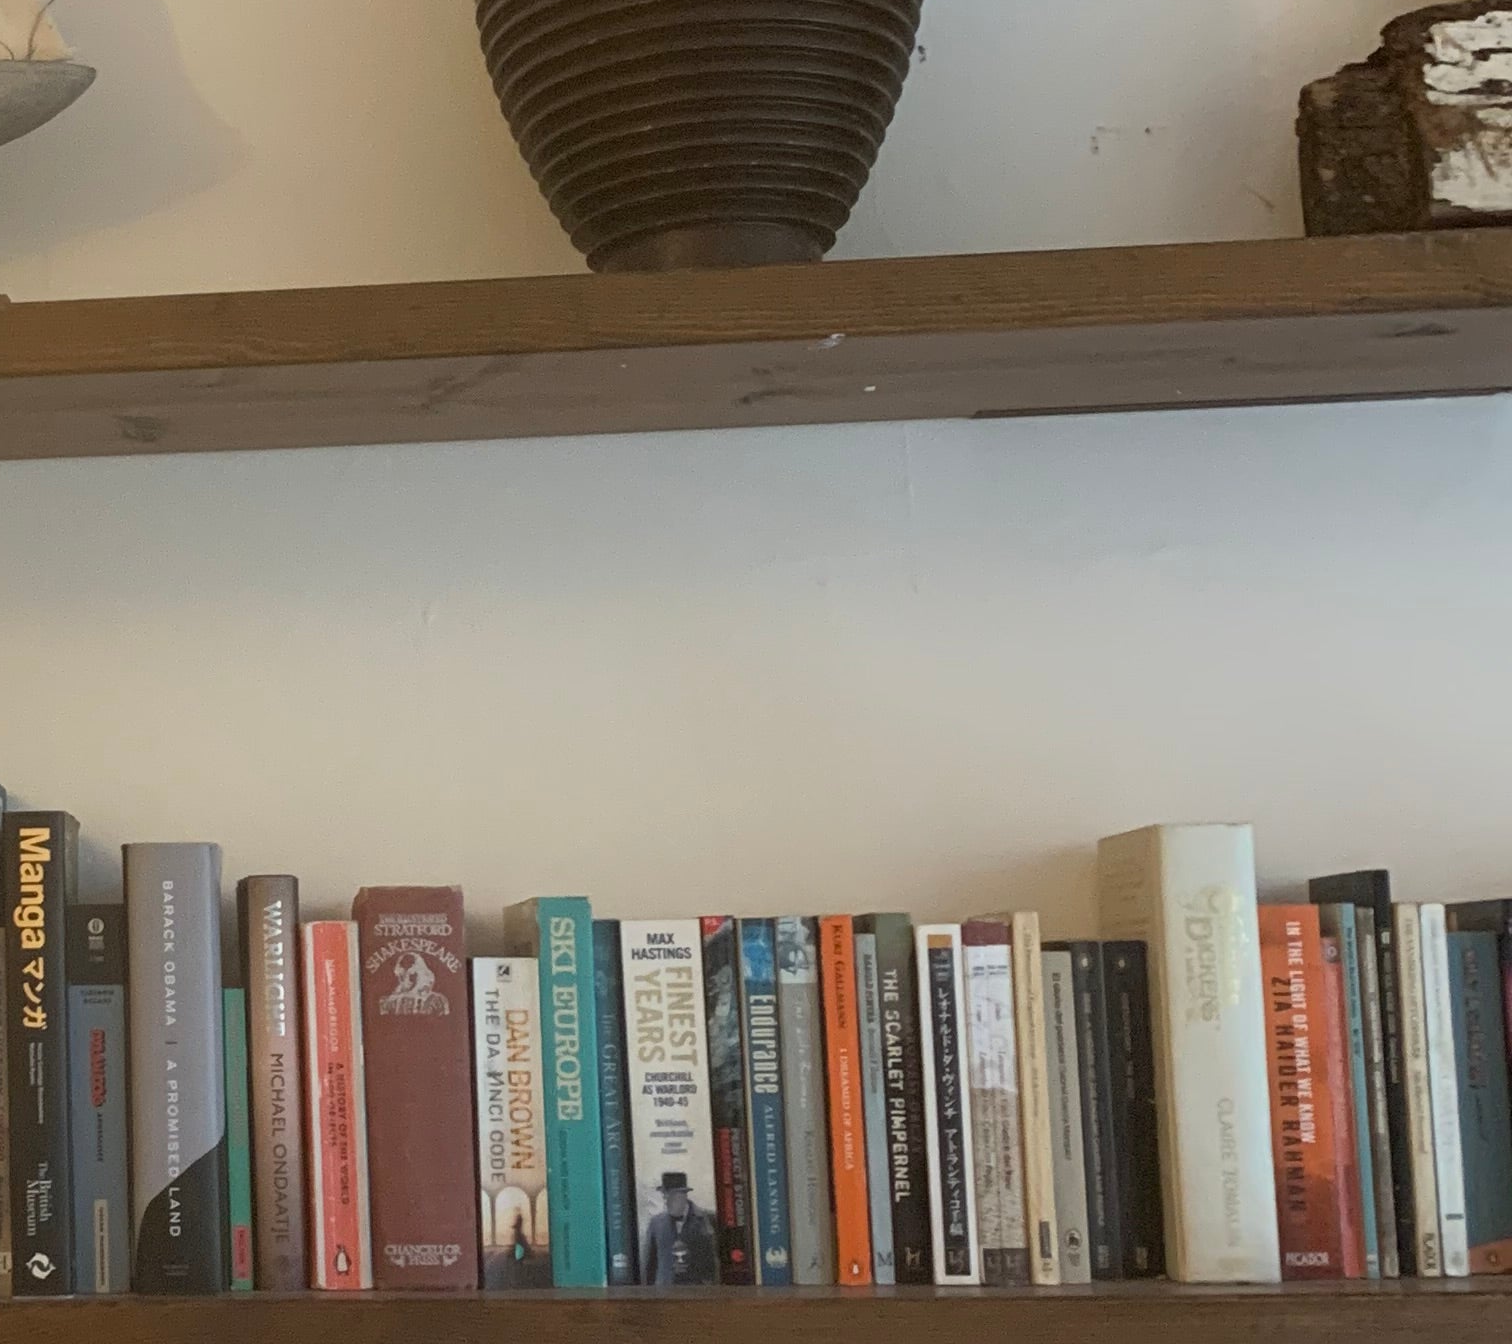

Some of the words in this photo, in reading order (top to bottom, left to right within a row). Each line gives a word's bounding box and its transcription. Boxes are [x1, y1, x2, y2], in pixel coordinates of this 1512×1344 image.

[12, 827, 51, 950] Manga
[161, 880, 176, 953] BARACK
[374, 924, 453, 937] STRATFORD
[646, 932, 675, 946] MAX
[1285, 920, 1301, 936] IN
[261, 899, 287, 1037] WARLIGHT
[365, 937, 462, 974] SHAKESPEARE
[550, 915, 577, 976] SKI
[631, 946, 692, 961] HASTINGS
[1287, 941, 1304, 965] THE
[21, 958, 48, 1031] マンガ
[163, 961, 178, 1027] OBAMA
[484, 989, 501, 1025] THE
[833, 960, 848, 1029] GALLMANN
[882, 969, 900, 1002] THE
[1271, 976, 1291, 1012] ZIA
[1289, 969, 1307, 1009] LIGHT
[504, 1009, 533, 1063] DAN
[633, 969, 665, 1064] YEARS
[665, 966, 698, 1067] FINEST
[1292, 1014, 1309, 1032] OF
[165, 1059, 178, 1072] A
[485, 1033, 502, 1059] DA
[552, 984, 584, 1121] EUROPE
[748, 994, 781, 1095] Endurance
[884, 1009, 905, 1091] SCARLET
[1275, 1025, 1297, 1107] HAIDER
[1294, 1037, 1312, 1074] WHAT
[269, 1052, 291, 1137] MICHAEL
[336, 1074, 346, 1120] HISTORY
[602, 1043, 620, 1106] GREAT
[641, 1085, 655, 1096] AS
[657, 1083, 698, 1096] WARLORD
[644, 1071, 694, 1083] CHURCHILL
[839, 1056, 851, 1110] DREAMED
[1297, 1078, 1313, 1100] WE
[165, 1080, 181, 1179] PROMISED
[506, 1070, 535, 1171] BROWN
[605, 1117, 624, 1152] ARC
[763, 1104, 776, 1163] ALFRED
[842, 1112, 853, 1127] OF
[1216, 1098, 1239, 1160] CLAIRE
[1299, 1103, 1316, 1144] KNOW
[38, 1161, 49, 1179] The
[488, 1129, 507, 1185] CODE
[729, 1127, 743, 1179] PERFECT
[842, 1129, 855, 1172] AFRICA
[888, 1097, 911, 1203] PIMPERNEL
[1282, 1120, 1307, 1212] RAHMAN
[26, 1180, 39, 1236] Museum
[38, 1179, 53, 1222] British
[270, 1143, 291, 1245] ONDAATJE
[339, 1165, 350, 1206] WORLD
[733, 1183, 746, 1228] STORM
[767, 1168, 781, 1235] LANSING
[167, 1186, 182, 1238] LAND
[384, 1244, 463, 1257] CHANCELLOR
